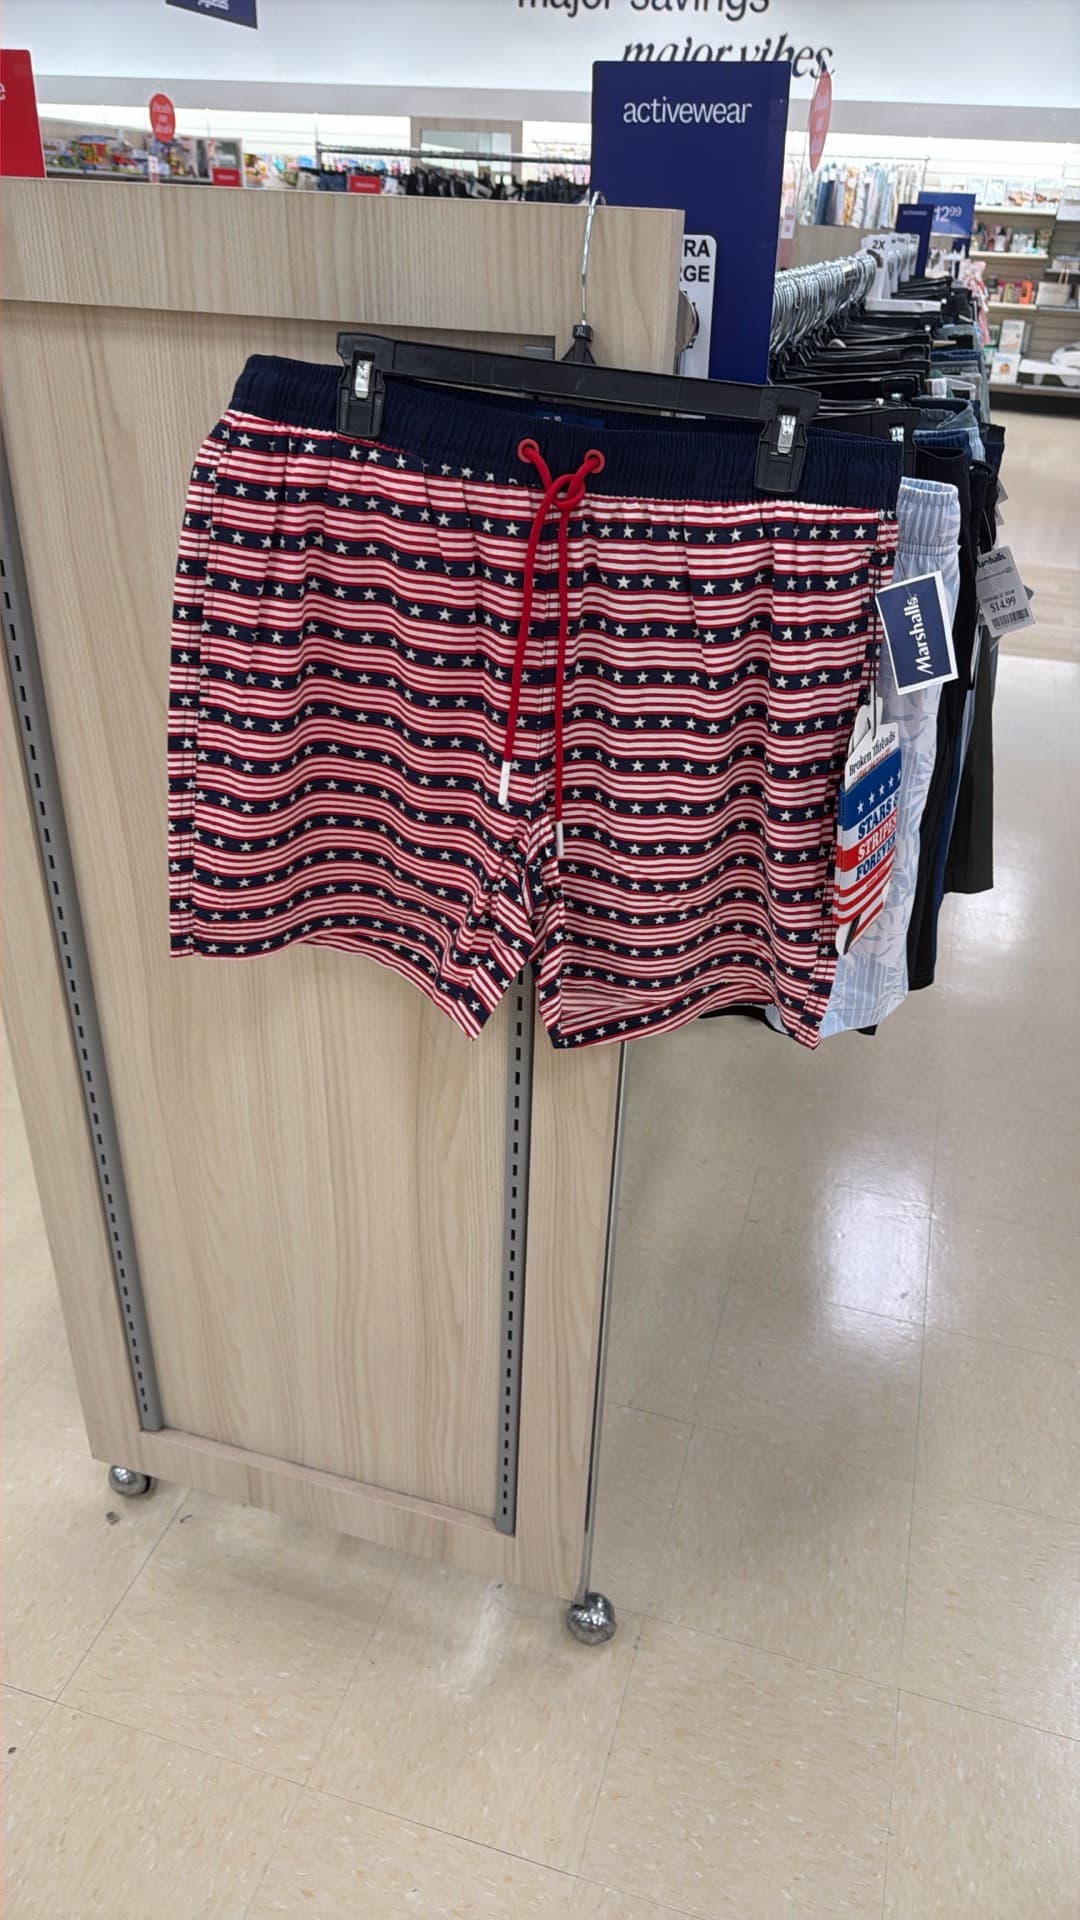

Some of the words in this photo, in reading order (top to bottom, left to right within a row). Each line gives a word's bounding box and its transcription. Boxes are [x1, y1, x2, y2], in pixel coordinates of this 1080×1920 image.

[623, 95, 753, 124] activewear
[680, 265, 710, 282] GE
[903, 594, 935, 676] Marshalls
[849, 752, 872, 776] Broken
[857, 812, 897, 861] STRIPES
[858, 798, 892, 840] STARS
